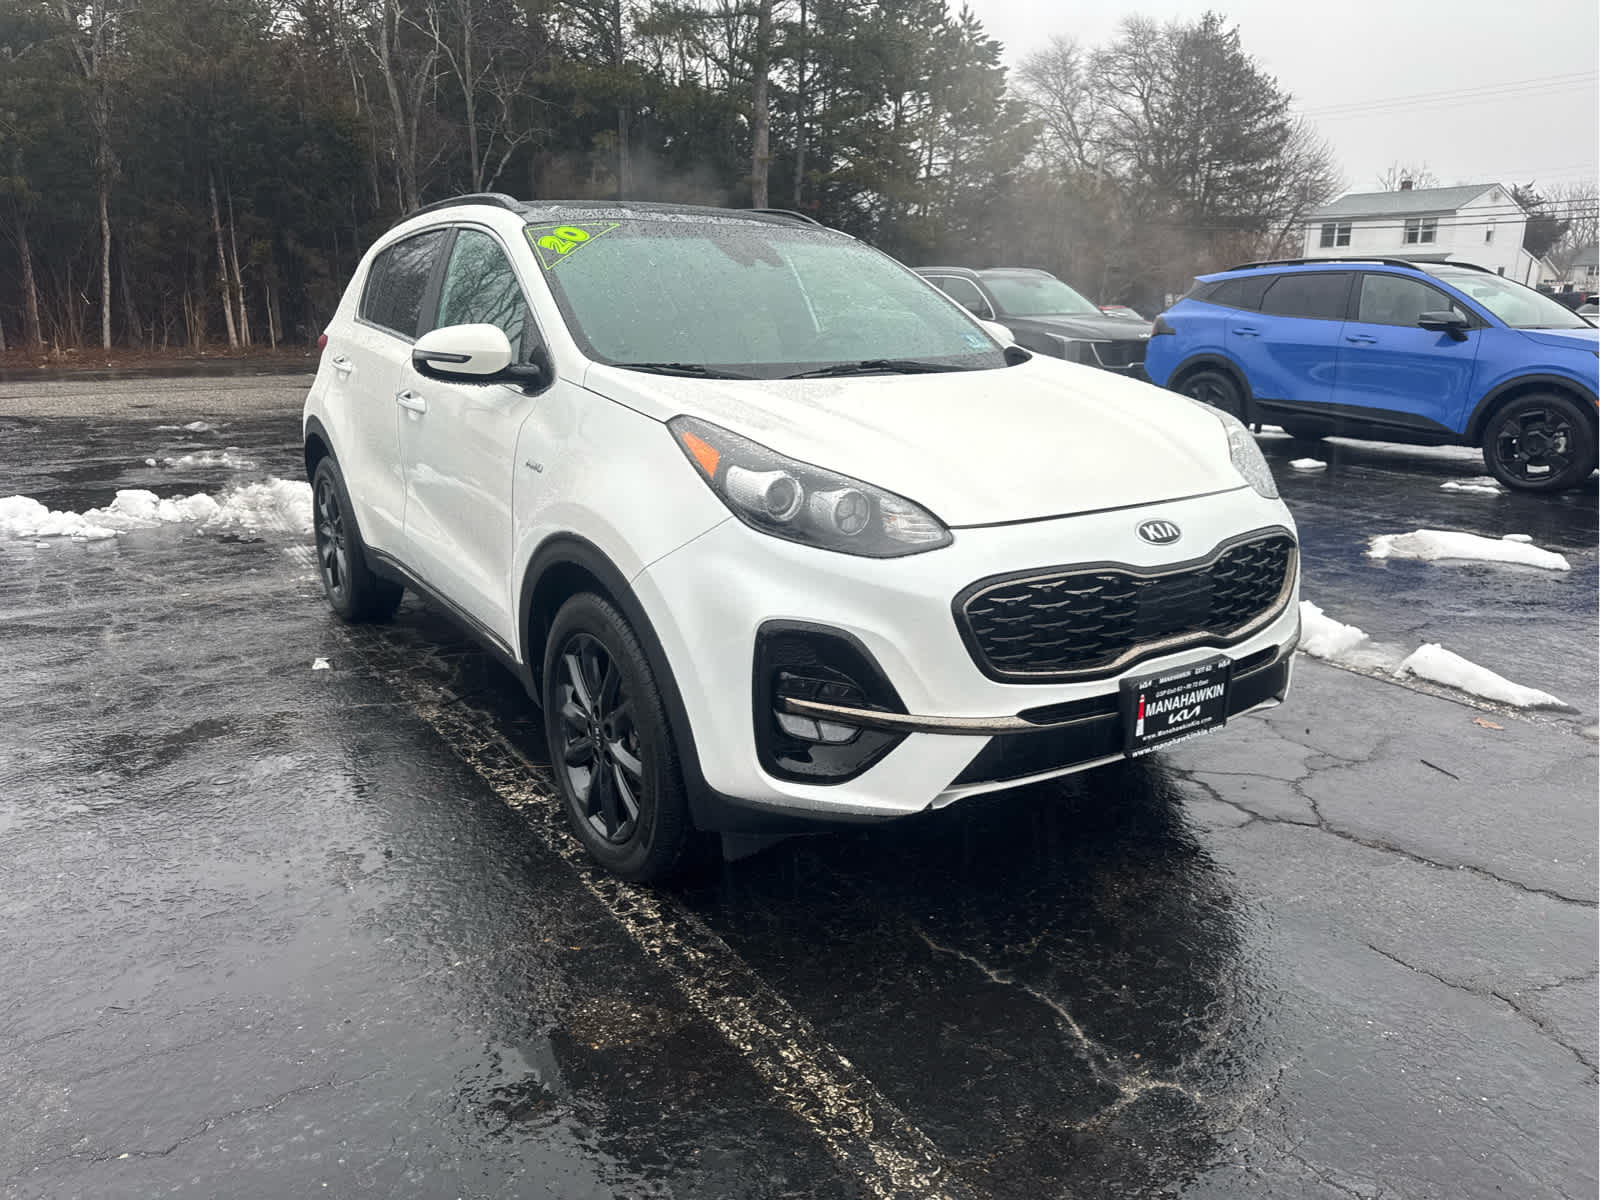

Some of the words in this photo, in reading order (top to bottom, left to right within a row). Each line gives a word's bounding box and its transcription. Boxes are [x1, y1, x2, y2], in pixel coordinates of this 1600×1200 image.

[537, 226, 590, 254] 20
[1142, 522, 1179, 540] KIA
[1145, 683, 1224, 717] MANAHAWKIN
